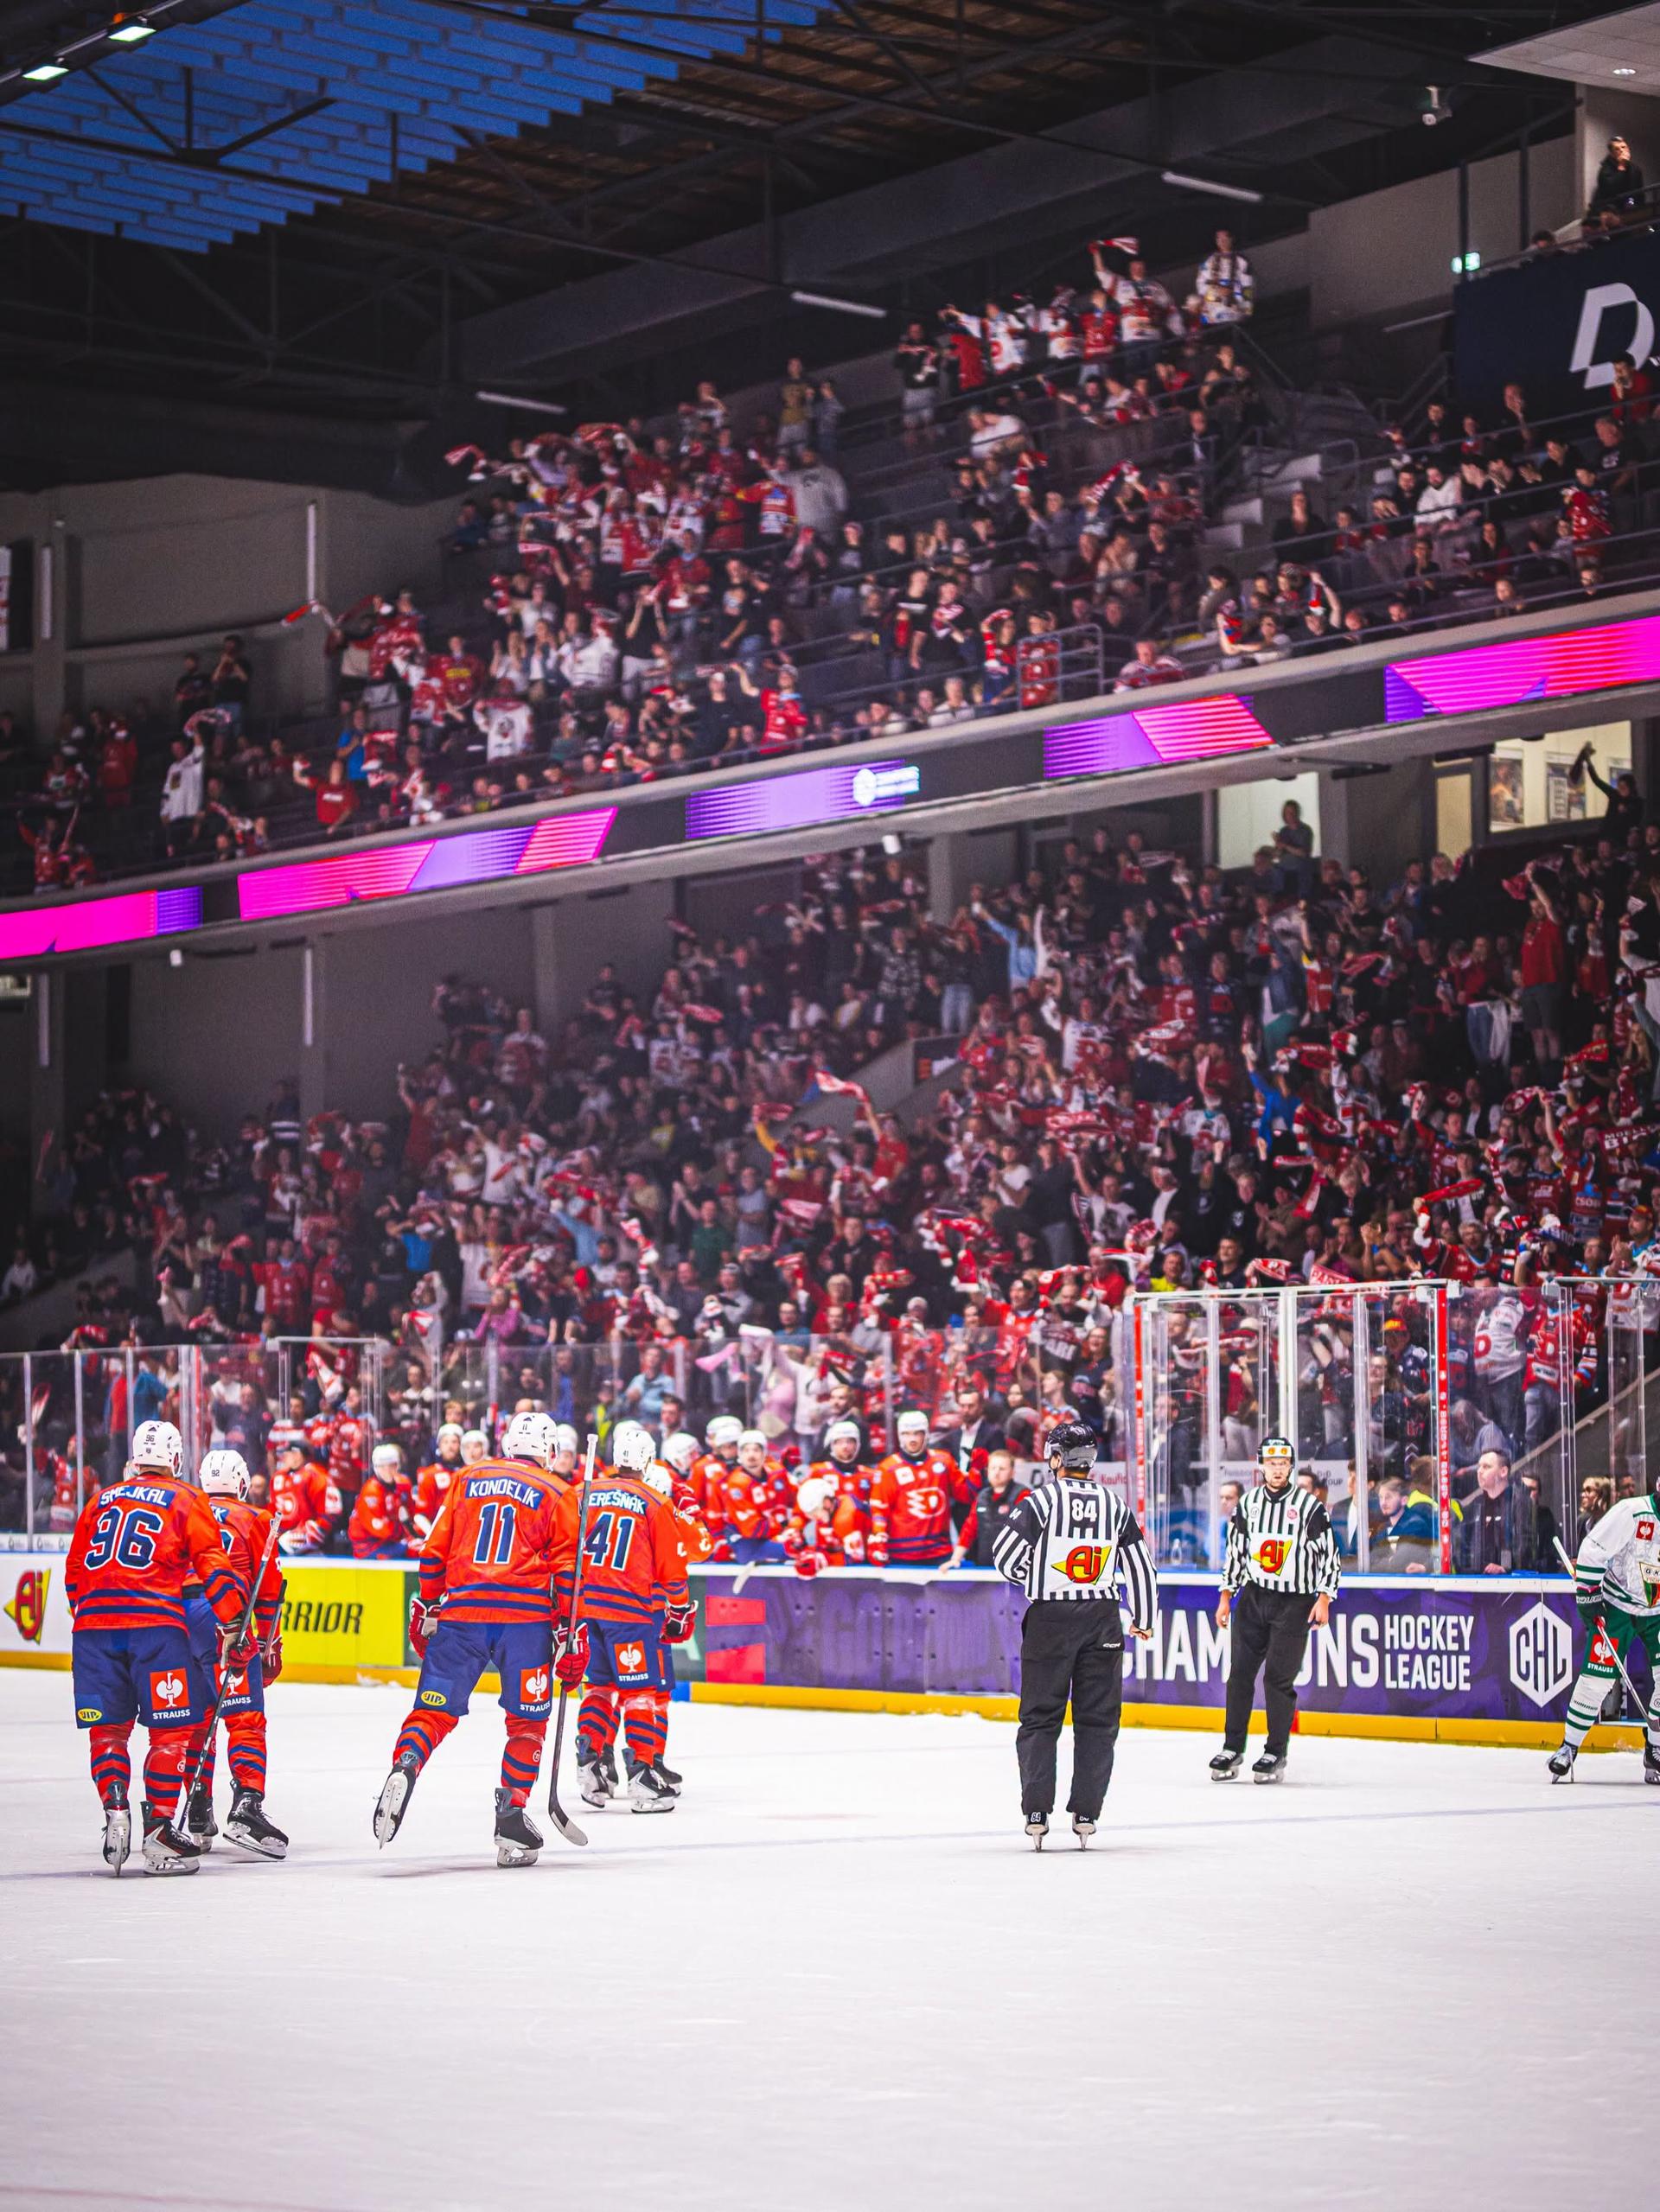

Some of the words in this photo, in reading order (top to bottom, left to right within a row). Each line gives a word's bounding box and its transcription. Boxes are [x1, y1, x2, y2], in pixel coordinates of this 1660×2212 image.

[145, 1434, 155, 1443] 96
[99, 1485, 168, 1507] SMEJKAL
[469, 1478, 540, 1509] KONDELÍK
[588, 1488, 647, 1514] EREŠŇÁK
[1071, 1498, 1097, 1522] 84
[84, 1506, 164, 1571] 96
[473, 1502, 517, 1564] 11
[583, 1511, 635, 1571] 41
[283, 1601, 363, 1635] RRIOR
[1384, 1614, 1474, 1651] HOCKEY
[1516, 1616, 1567, 1692] CHL
[1587, 1662, 1614, 1673] STRAUSS
[618, 1673, 649, 1682] STRAUSS
[1384, 1653, 1471, 1691] LEAGUE
[152, 1709, 191, 1719] STRAUSS
[520, 1700, 551, 1712] STRAUSS
